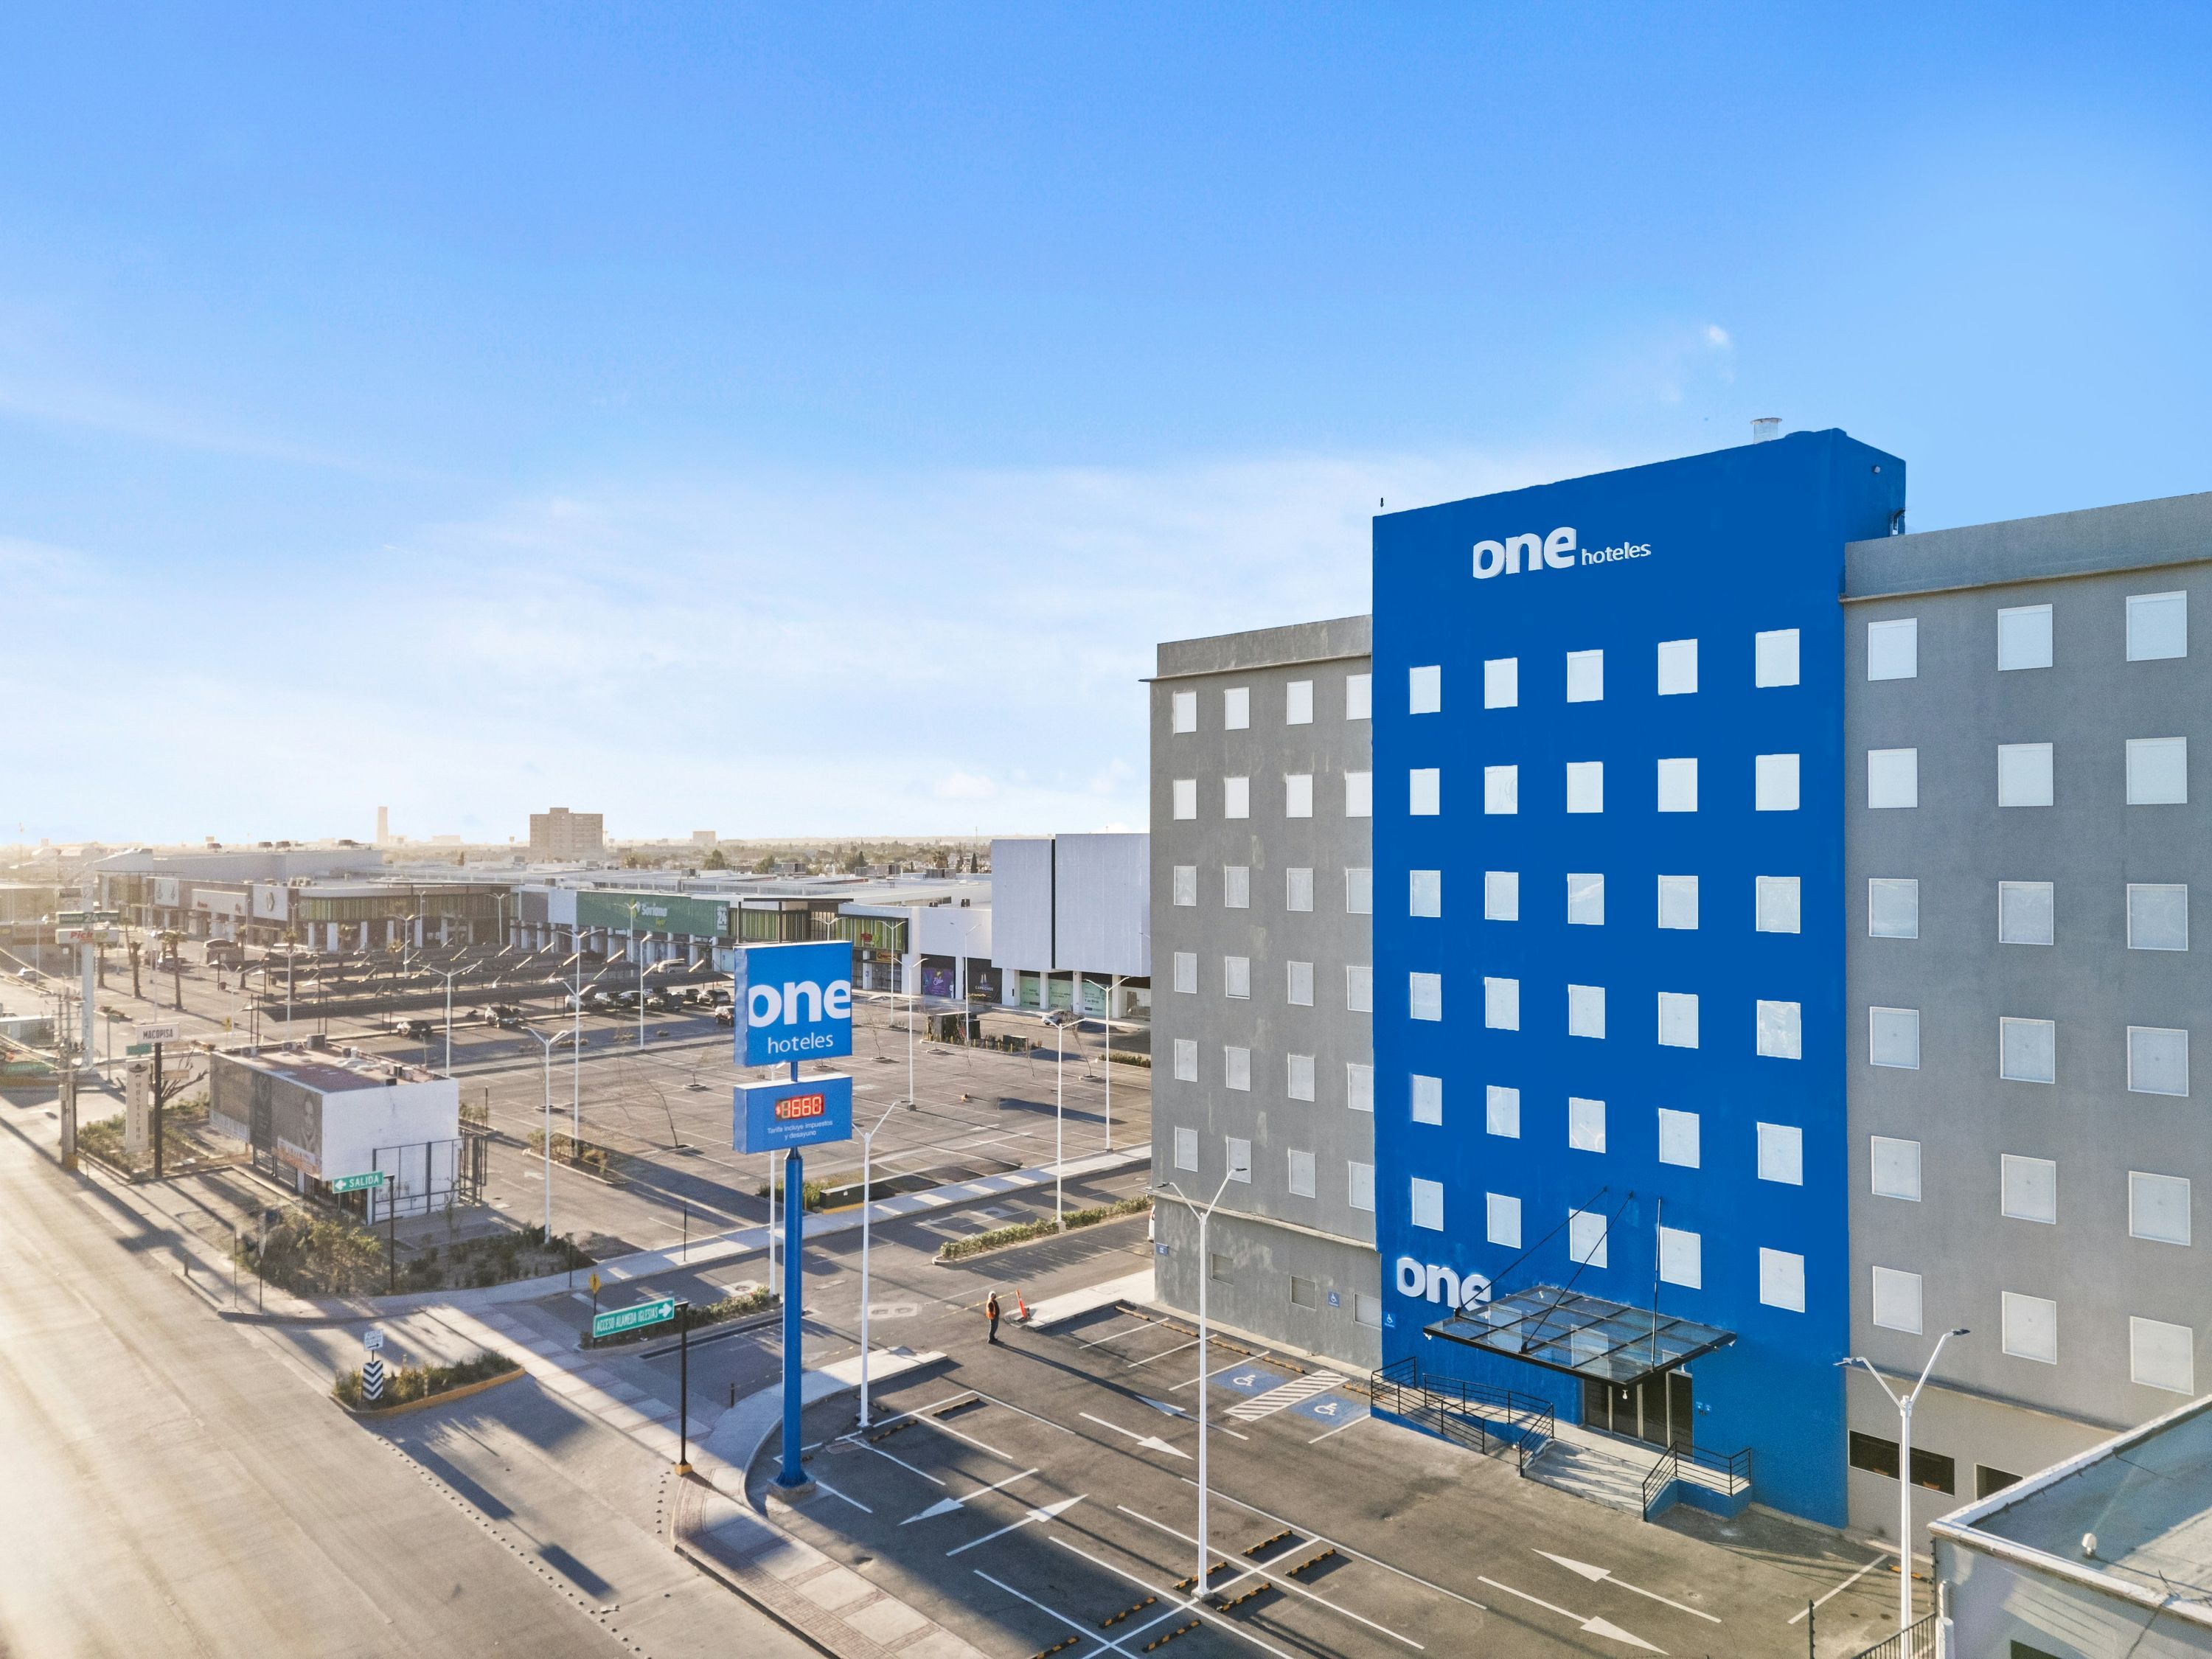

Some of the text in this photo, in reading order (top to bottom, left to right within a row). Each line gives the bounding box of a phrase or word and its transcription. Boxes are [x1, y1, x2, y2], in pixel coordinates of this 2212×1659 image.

[1473, 526, 1651, 579] one hoteles
[748, 980, 851, 1027] one
[143, 1029, 173, 1040] MACOPISA
[768, 1032, 833, 1054] hoteles
[790, 1130, 816, 1139] desayuno
[805, 1121, 833, 1129] impuestos
[349, 1175, 378, 1187] SALIDA
[1397, 1257, 1492, 1312] one
[597, 1307, 658, 1333] ACCESO ALAMEDA IGLESIAS
